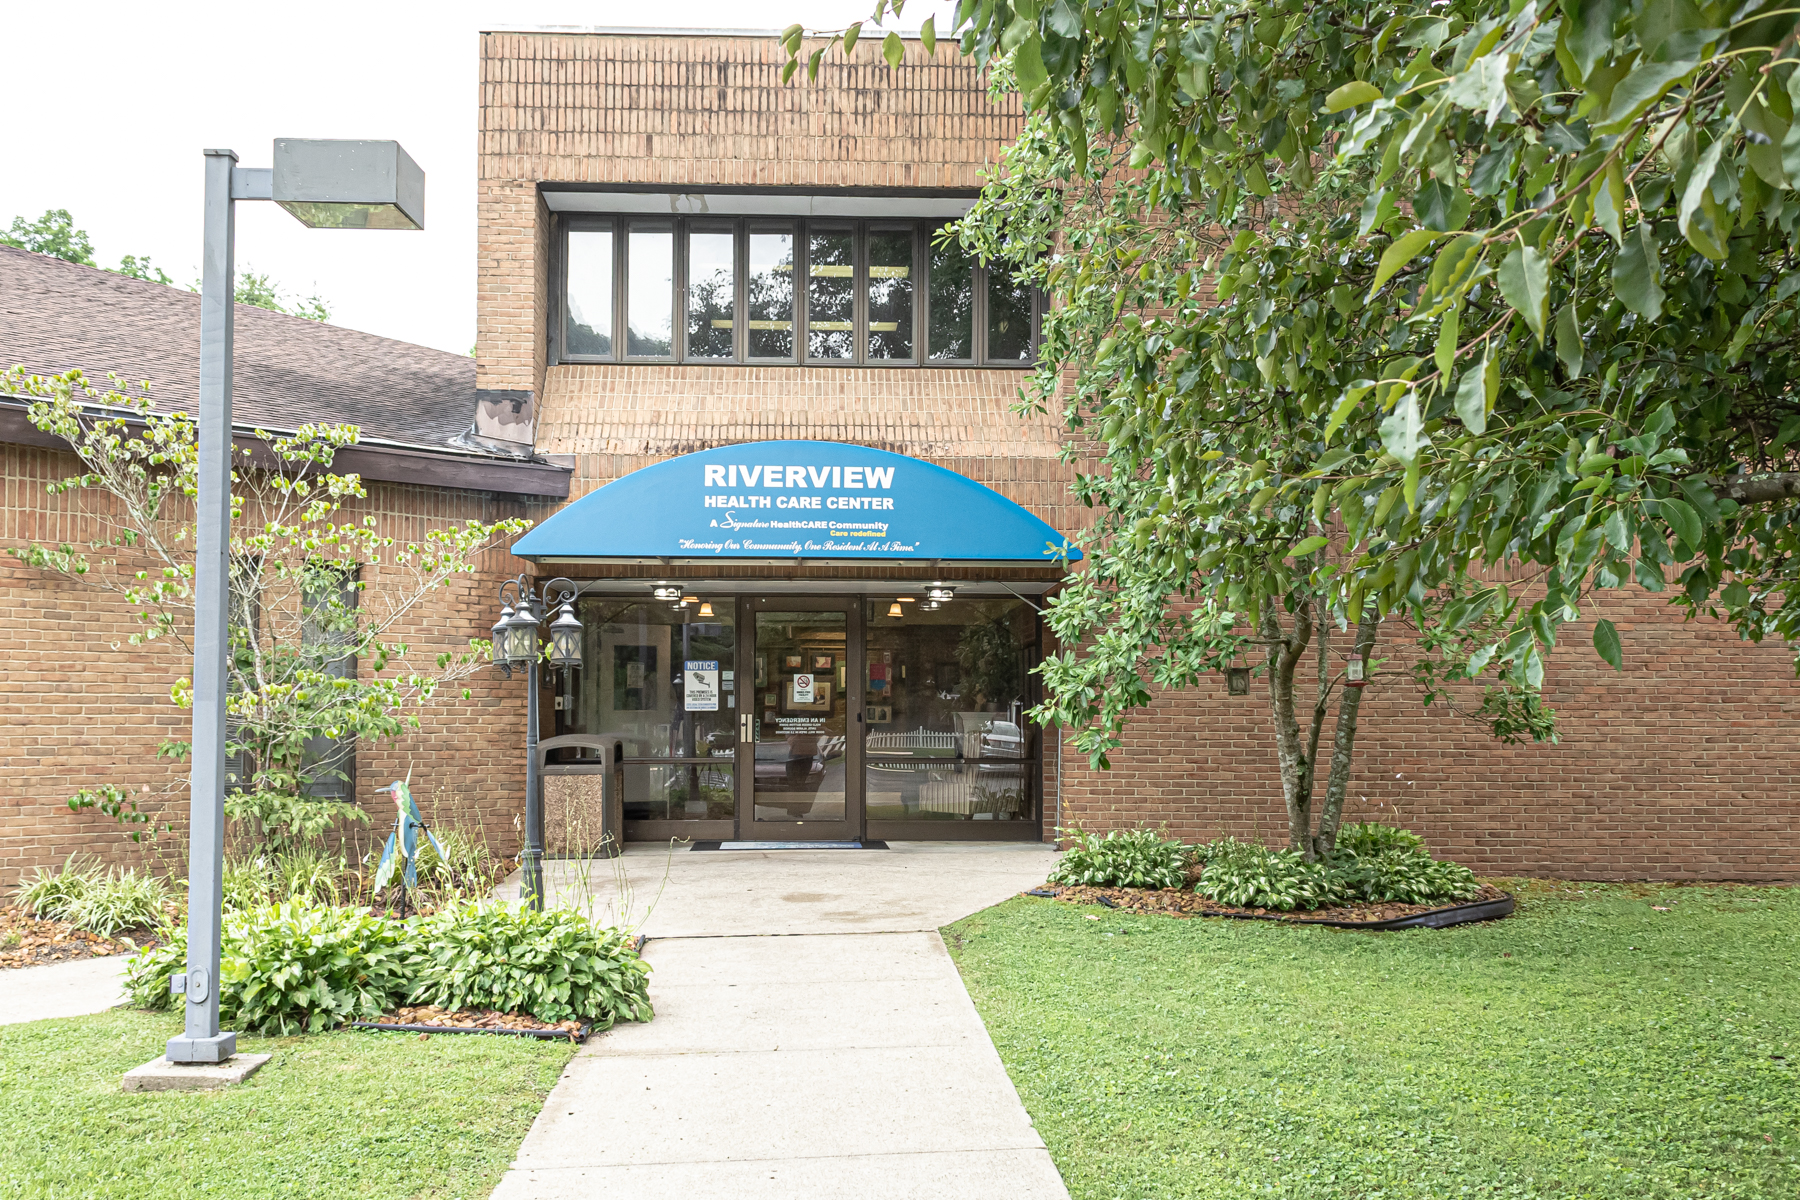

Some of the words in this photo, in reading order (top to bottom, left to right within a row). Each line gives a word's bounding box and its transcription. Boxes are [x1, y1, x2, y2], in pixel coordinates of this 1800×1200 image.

[704, 464, 895, 489] RIVERVIEW
[704, 495, 771, 508] HEALTH
[776, 496, 822, 509] CARE
[826, 497, 895, 510] CENTER
[709, 519, 718, 527] A
[720, 510, 769, 531] Signature
[770, 520, 828, 529] HealthCARE
[828, 521, 889, 531] Community
[724, 539, 740, 549] Our
[804, 540, 821, 550] One
[822, 540, 864, 551] Resident
[863, 541, 878, 551] At
[878, 541, 890, 551] A
[687, 662, 715, 670] NOTICE
